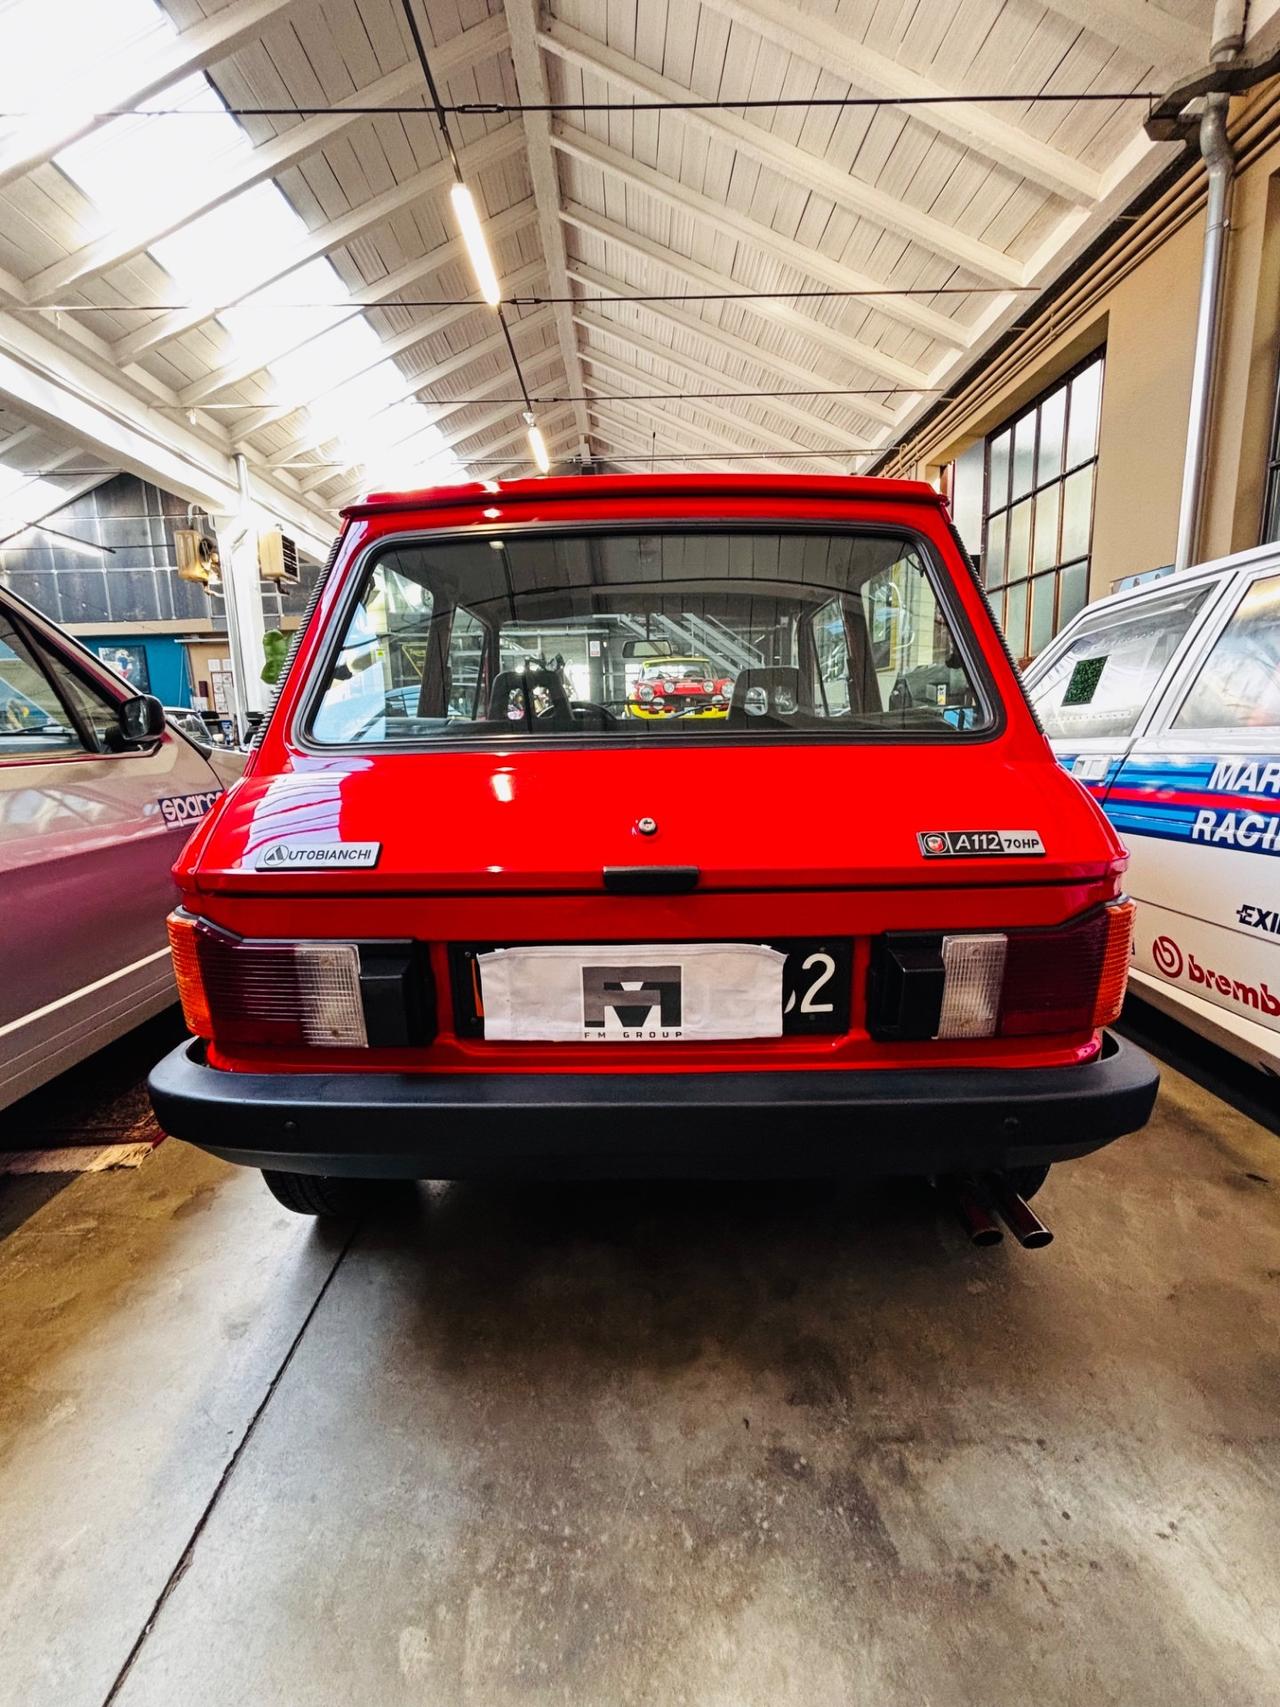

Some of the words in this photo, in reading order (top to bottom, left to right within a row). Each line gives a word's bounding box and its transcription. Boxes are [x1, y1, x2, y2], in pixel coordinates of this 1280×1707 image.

[955, 834, 1000, 850] A112
[1004, 839, 1040, 849] 70HP
[1192, 809, 1280, 851] RACI
[1236, 904, 1280, 935] EXI
[784, 953, 836, 1014] 2
